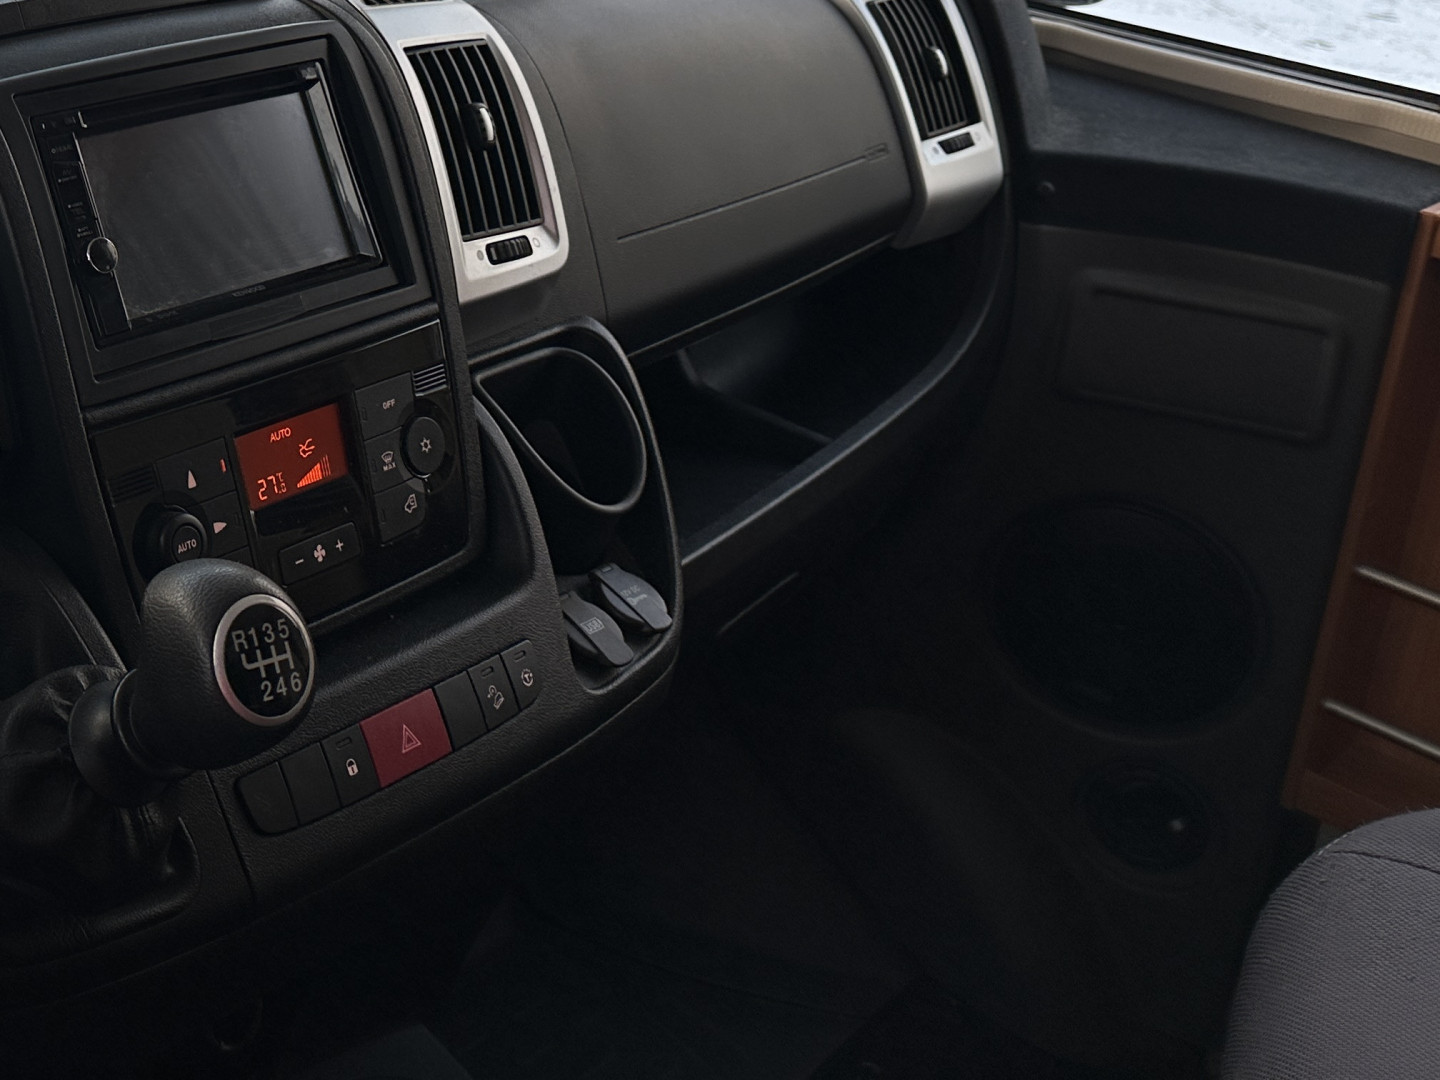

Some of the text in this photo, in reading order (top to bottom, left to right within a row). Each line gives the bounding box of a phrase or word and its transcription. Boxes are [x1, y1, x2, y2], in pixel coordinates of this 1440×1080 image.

[382, 399, 396, 410] OFF
[270, 427, 292, 443] AUTO
[177, 538, 197, 555] AUTO
